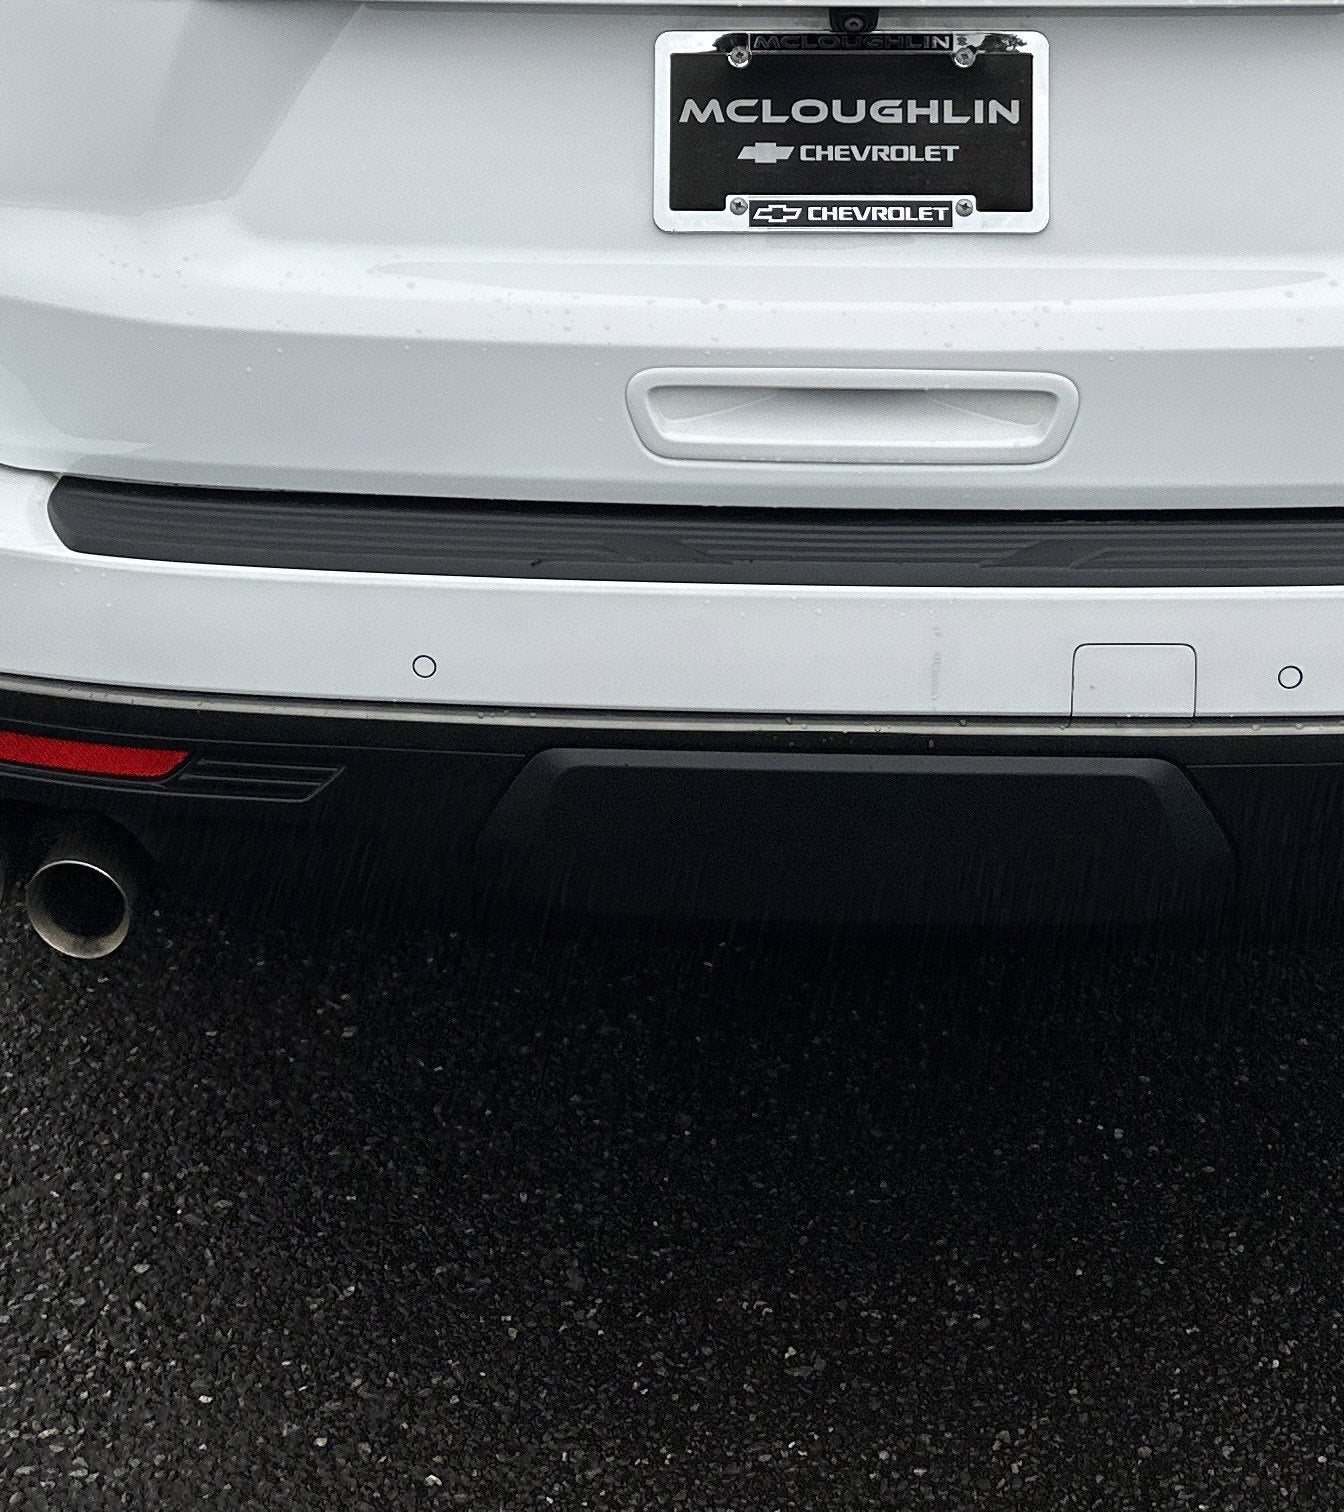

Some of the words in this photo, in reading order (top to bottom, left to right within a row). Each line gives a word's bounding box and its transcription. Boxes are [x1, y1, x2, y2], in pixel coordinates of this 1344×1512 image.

[753, 35, 951, 50] MCLOUGHLIN
[678, 99, 1021, 124] MCLOUGHLIN
[800, 144, 960, 162] CHEVROLET
[807, 205, 950, 222] CHEVROLET
